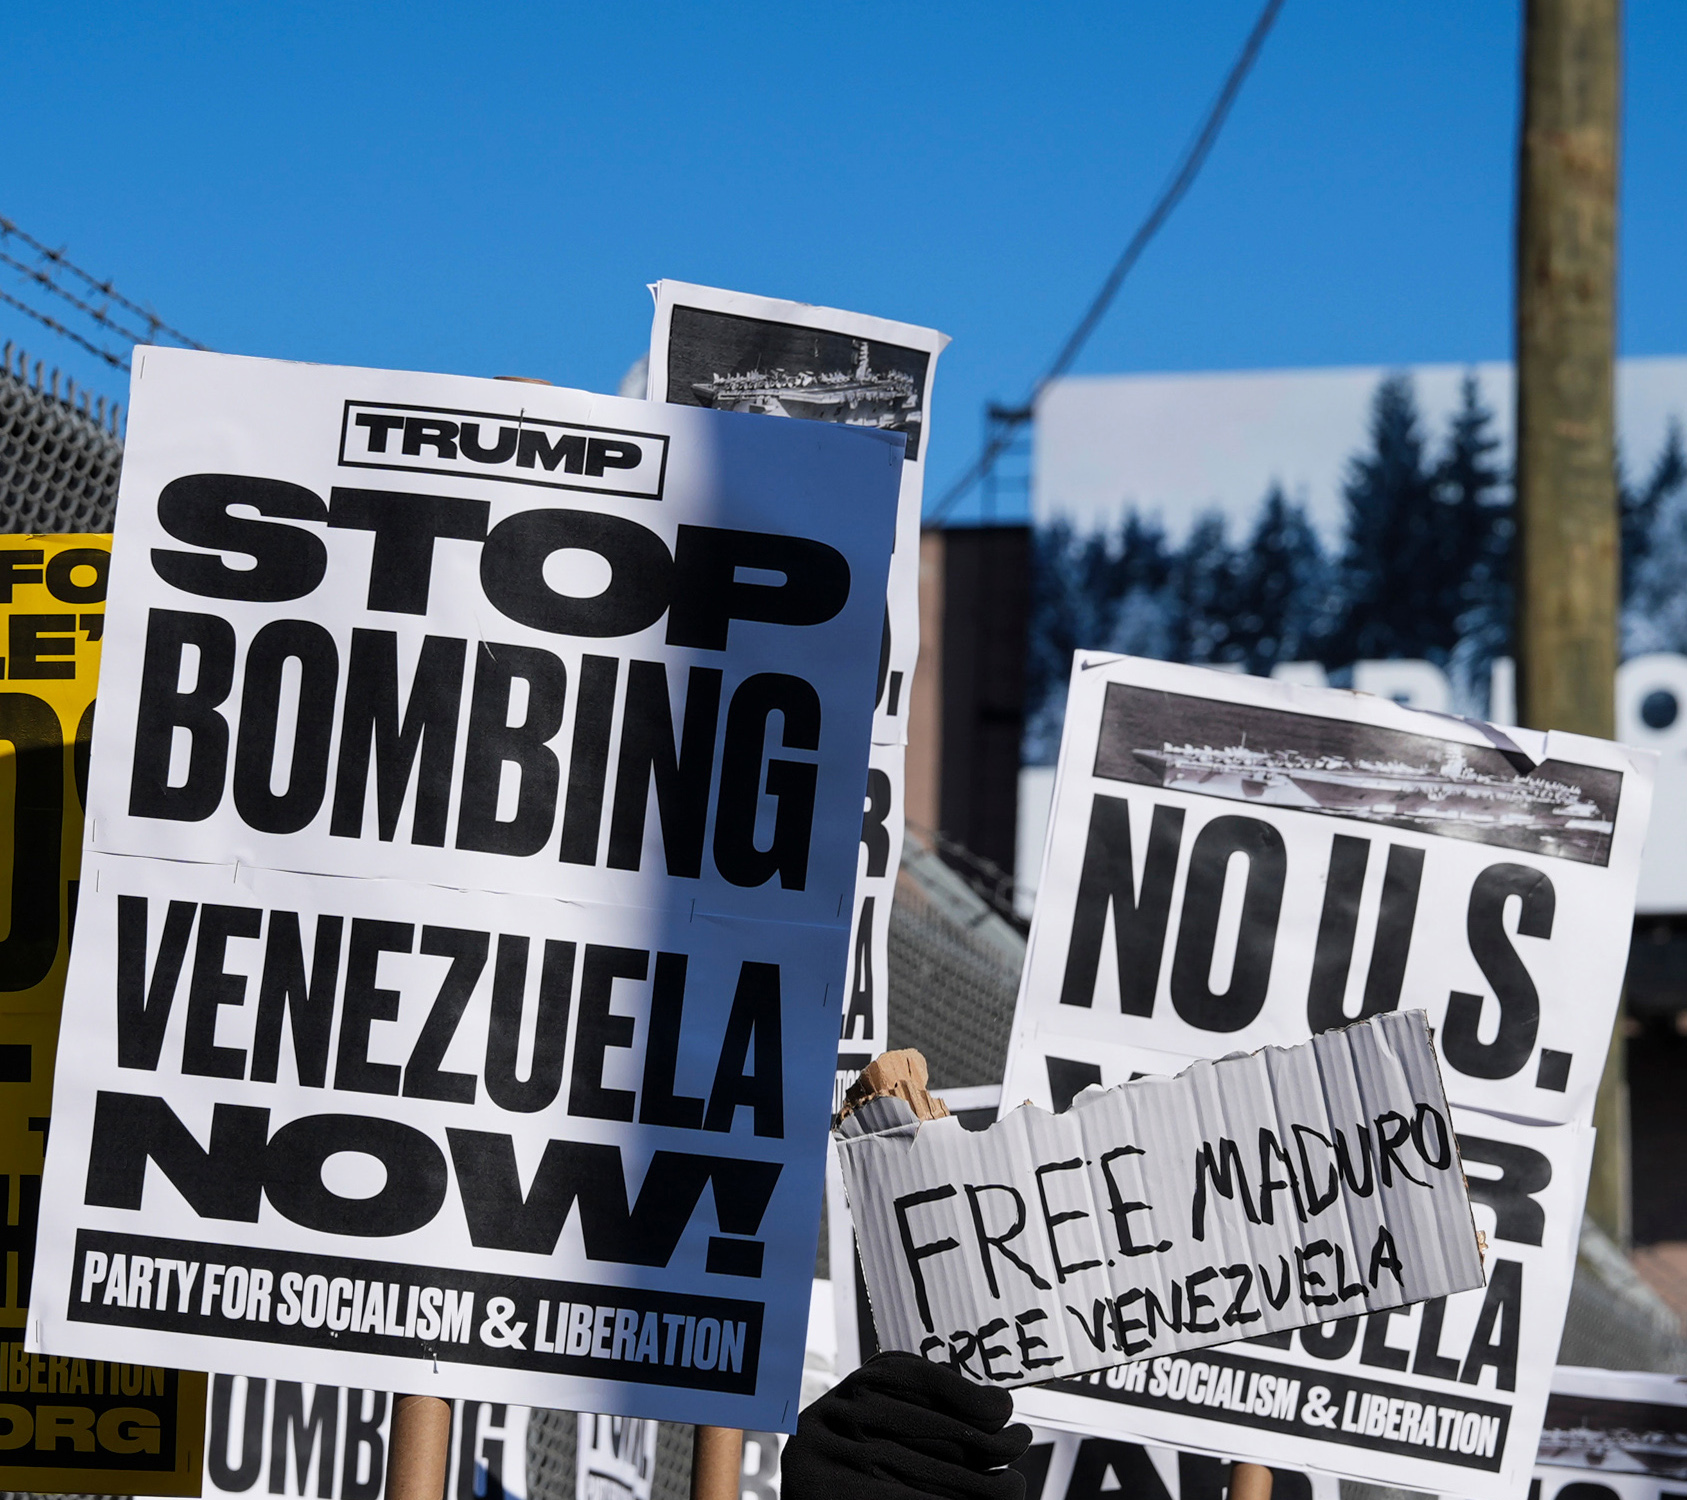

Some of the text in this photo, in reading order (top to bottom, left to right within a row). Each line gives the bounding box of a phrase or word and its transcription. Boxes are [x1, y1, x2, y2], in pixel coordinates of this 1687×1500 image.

[355, 412, 643, 476] TRUMP
[150, 473, 852, 651] STOP
[128, 607, 823, 892] BOMBING
[117, 895, 785, 1139] VENEZUELA
[1059, 793, 1288, 1033] NO
[1307, 833, 1573, 1093] US.
[84, 1090, 785, 1278] NOW!
[896, 1144, 1172, 1332] FREE
[1191, 1102, 1452, 1242] MADURO
[80, 1251, 748, 1374] PARTY FOR SOCIALISM & LIBERATION
[1066, 1224, 1405, 1357] VENEZUELA
[1148, 1356, 1301, 1422] SOCIALISM
[1300, 1386, 1338, 1428] &
[1341, 1390, 1501, 1458] LIBERATION
